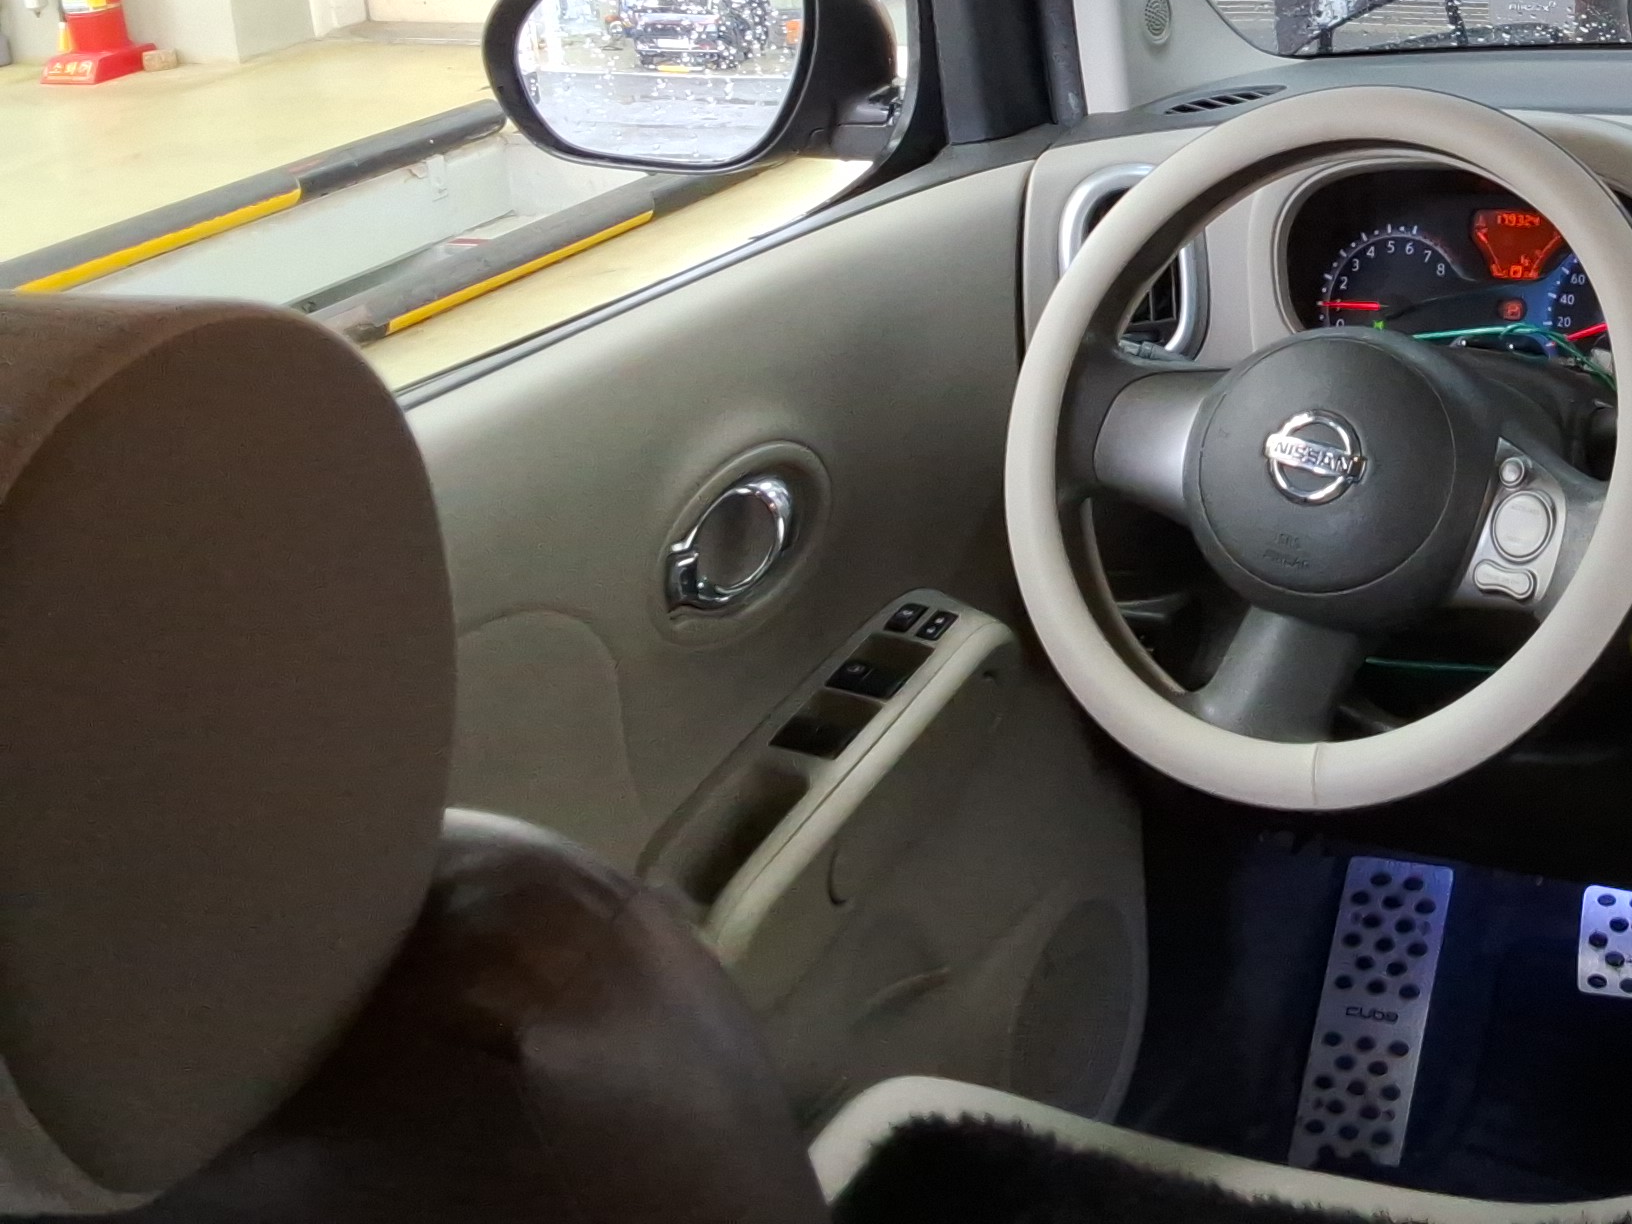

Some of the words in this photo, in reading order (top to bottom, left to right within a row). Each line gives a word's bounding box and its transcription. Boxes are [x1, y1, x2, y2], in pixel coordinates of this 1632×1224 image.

[1366, 246, 1375, 259] 4
[1386, 240, 1396, 254] 5
[1405, 242, 1415, 255] 6
[1423, 250, 1432, 263] 7
[1351, 259, 1360, 272] 3
[1436, 263, 1446, 277] 8
[1340, 276, 1348, 290] 2
[1570, 275, 1586, 285] 60
[1560, 294, 1575, 305] 40
[1557, 316, 1571, 327] 20
[1273, 440, 1354, 475] NISSAN
